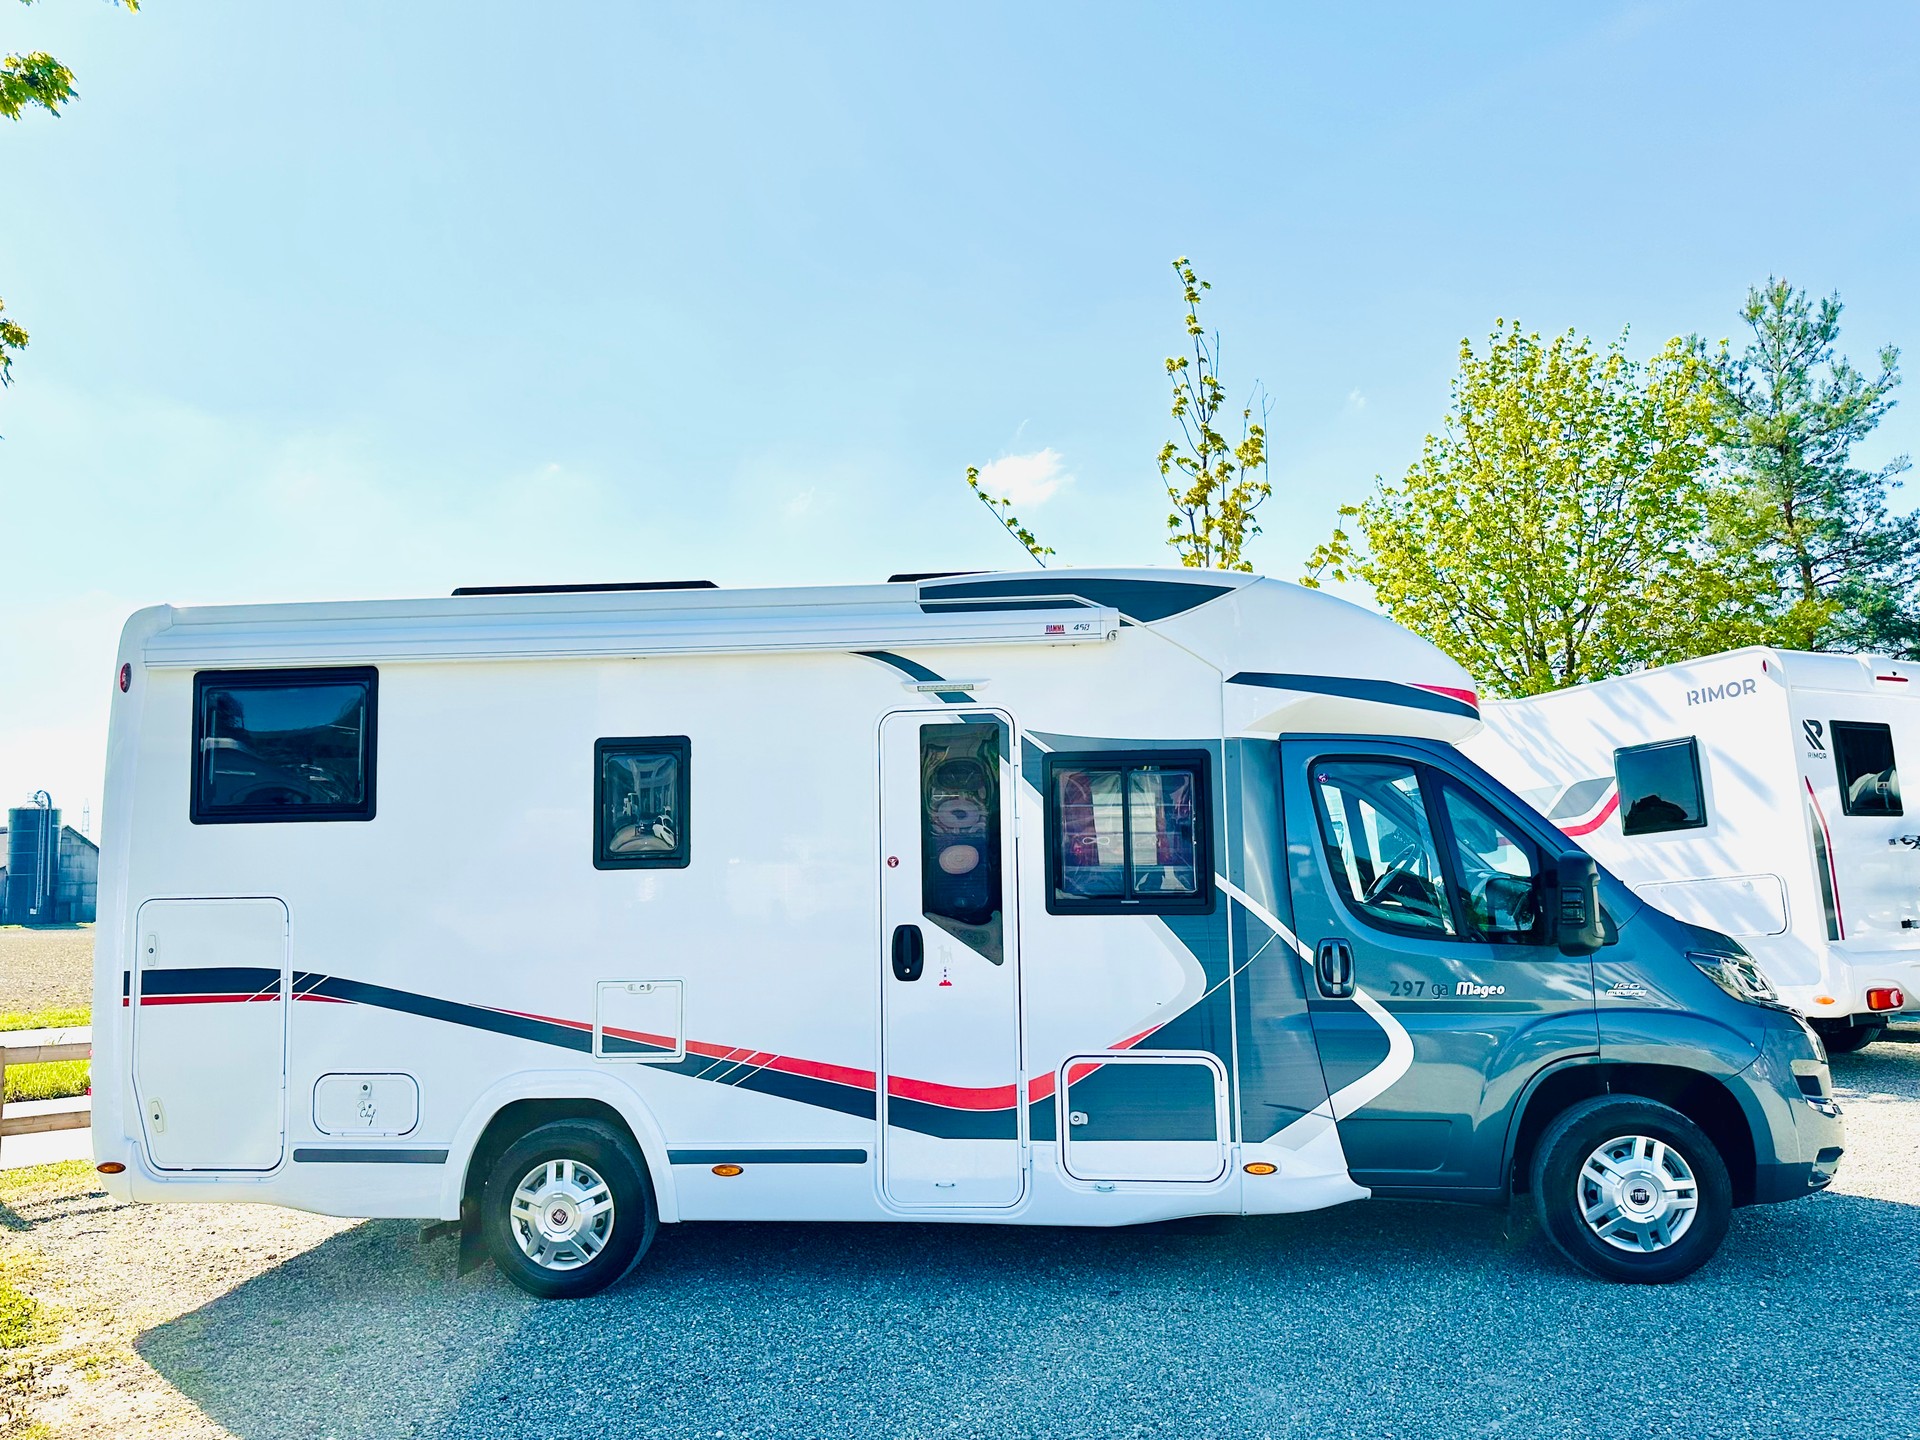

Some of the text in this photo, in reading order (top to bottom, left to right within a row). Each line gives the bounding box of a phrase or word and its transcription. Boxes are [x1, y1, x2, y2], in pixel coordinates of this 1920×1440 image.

[1686, 678, 1756, 706] RIMOR
[1807, 752, 1827, 760] RIMOR
[1389, 980, 1506, 1000] 297 ga Mageo
